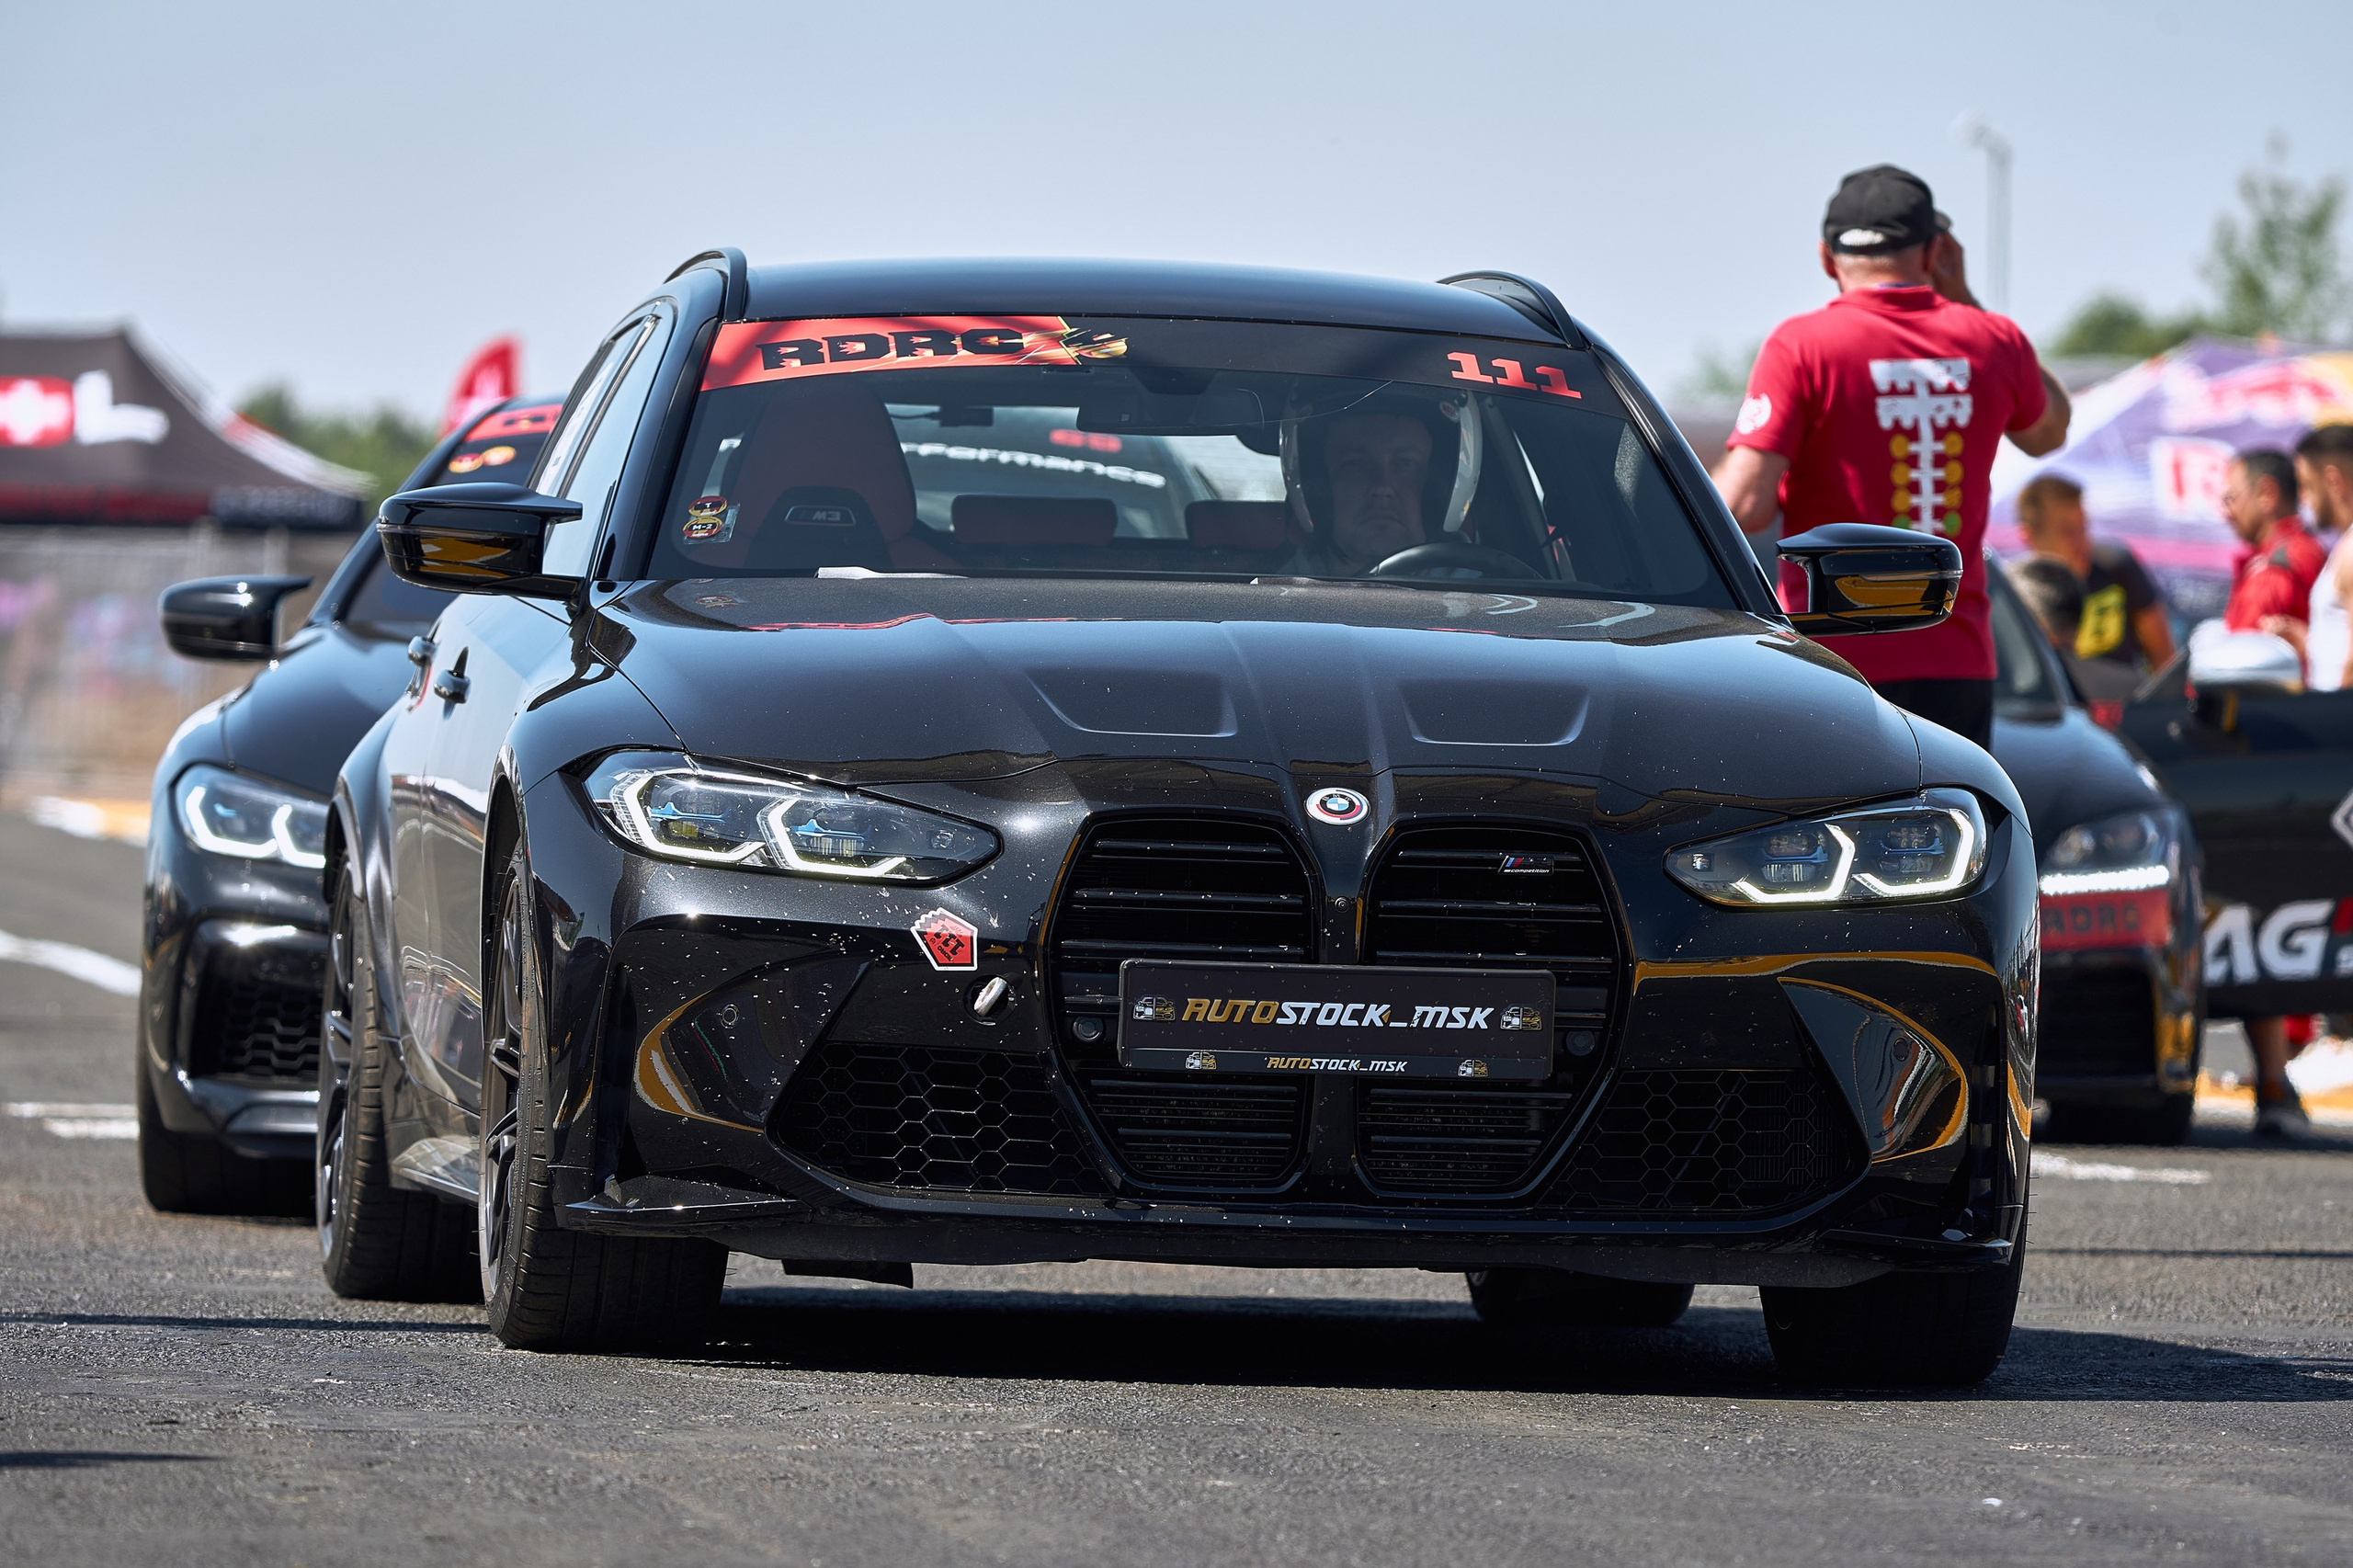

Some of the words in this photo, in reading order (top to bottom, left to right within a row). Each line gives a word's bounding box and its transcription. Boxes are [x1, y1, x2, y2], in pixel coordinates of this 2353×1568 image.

[756, 328, 1025, 369] RDRC
[1447, 351, 1582, 399] 111
[1181, 997, 1495, 1030] AUTOSTOCK_MSK
[1267, 1057, 1408, 1072] AUTOSTOCK_MSK
